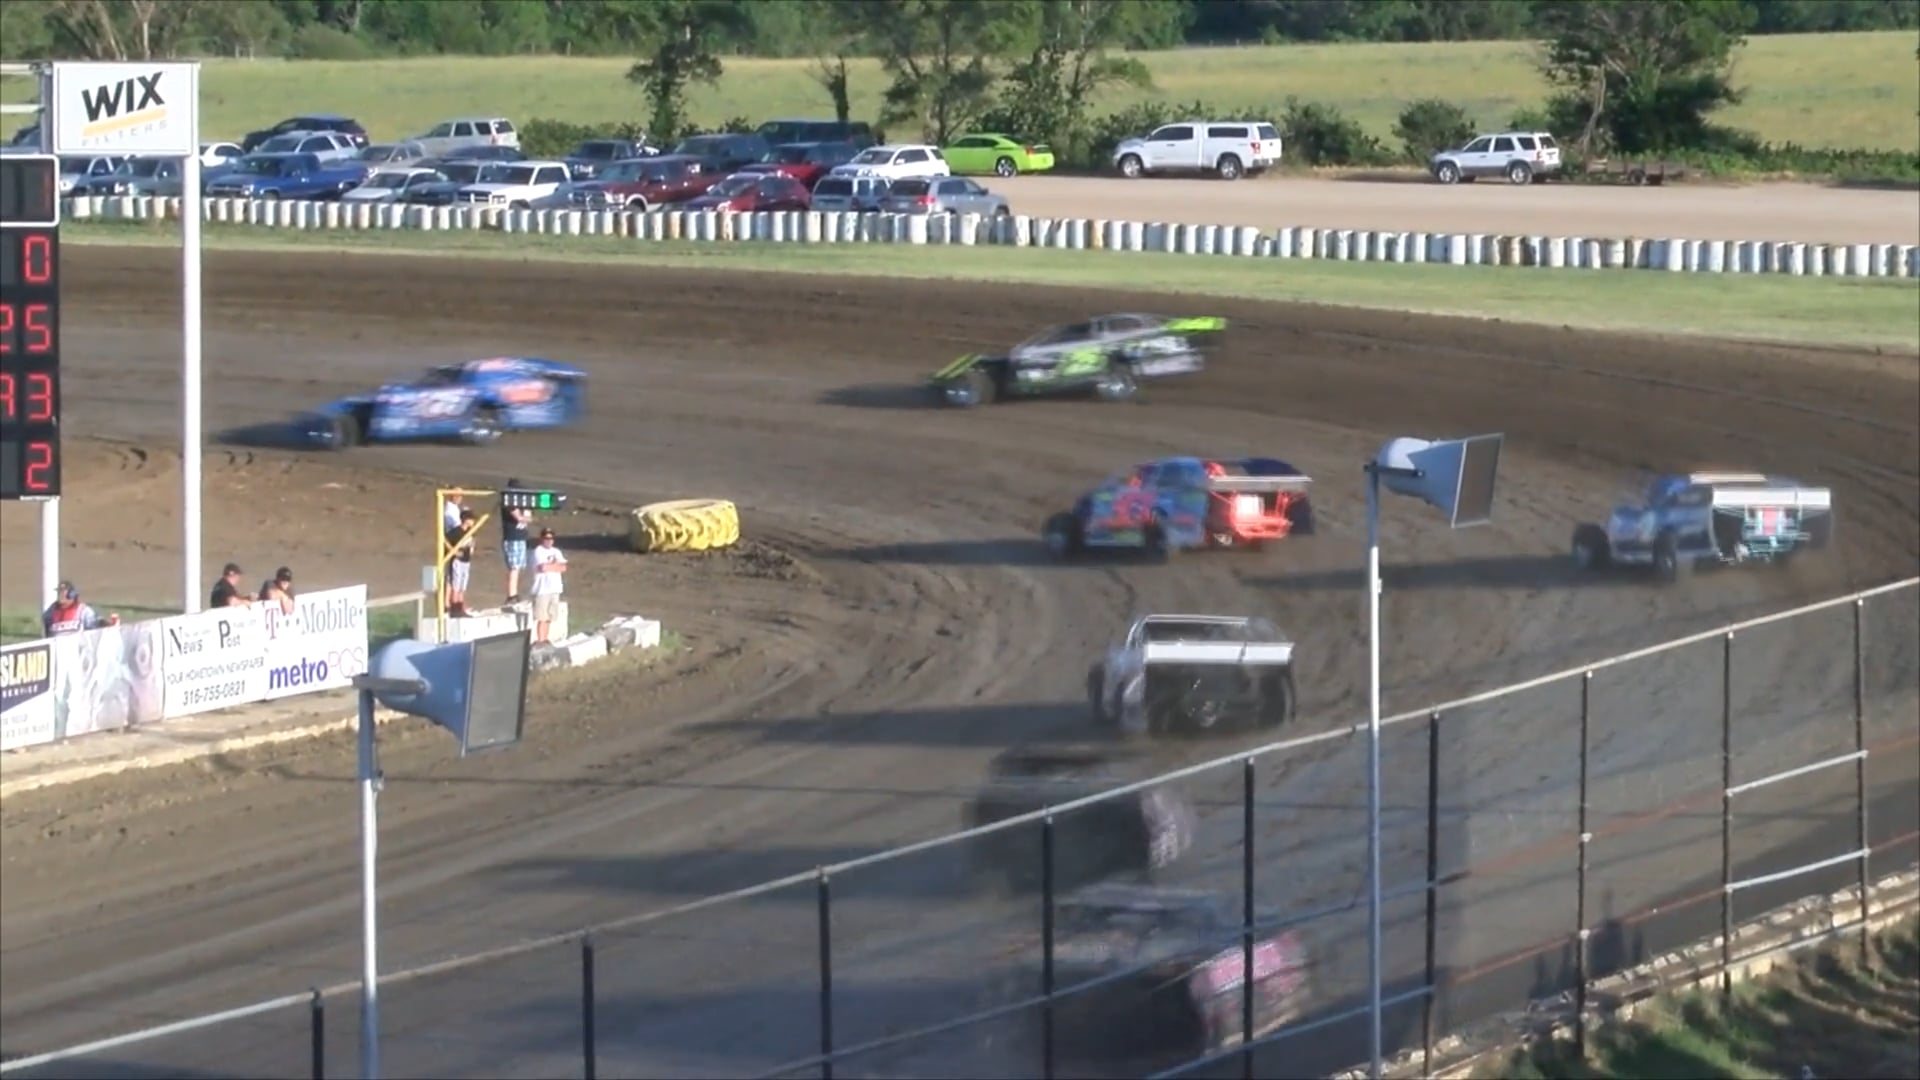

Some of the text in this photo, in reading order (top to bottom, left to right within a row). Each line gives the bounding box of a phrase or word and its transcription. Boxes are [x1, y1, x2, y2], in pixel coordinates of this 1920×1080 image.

[81, 71, 165, 122] WIX
[24, 235, 51, 284] 0
[26, 442, 52, 489] 2
[169, 620, 242, 657] News Post
[167, 656, 265, 685] YOUR HOMETOWN NEWSPAPER
[182, 679, 246, 707] 316-755-0821
